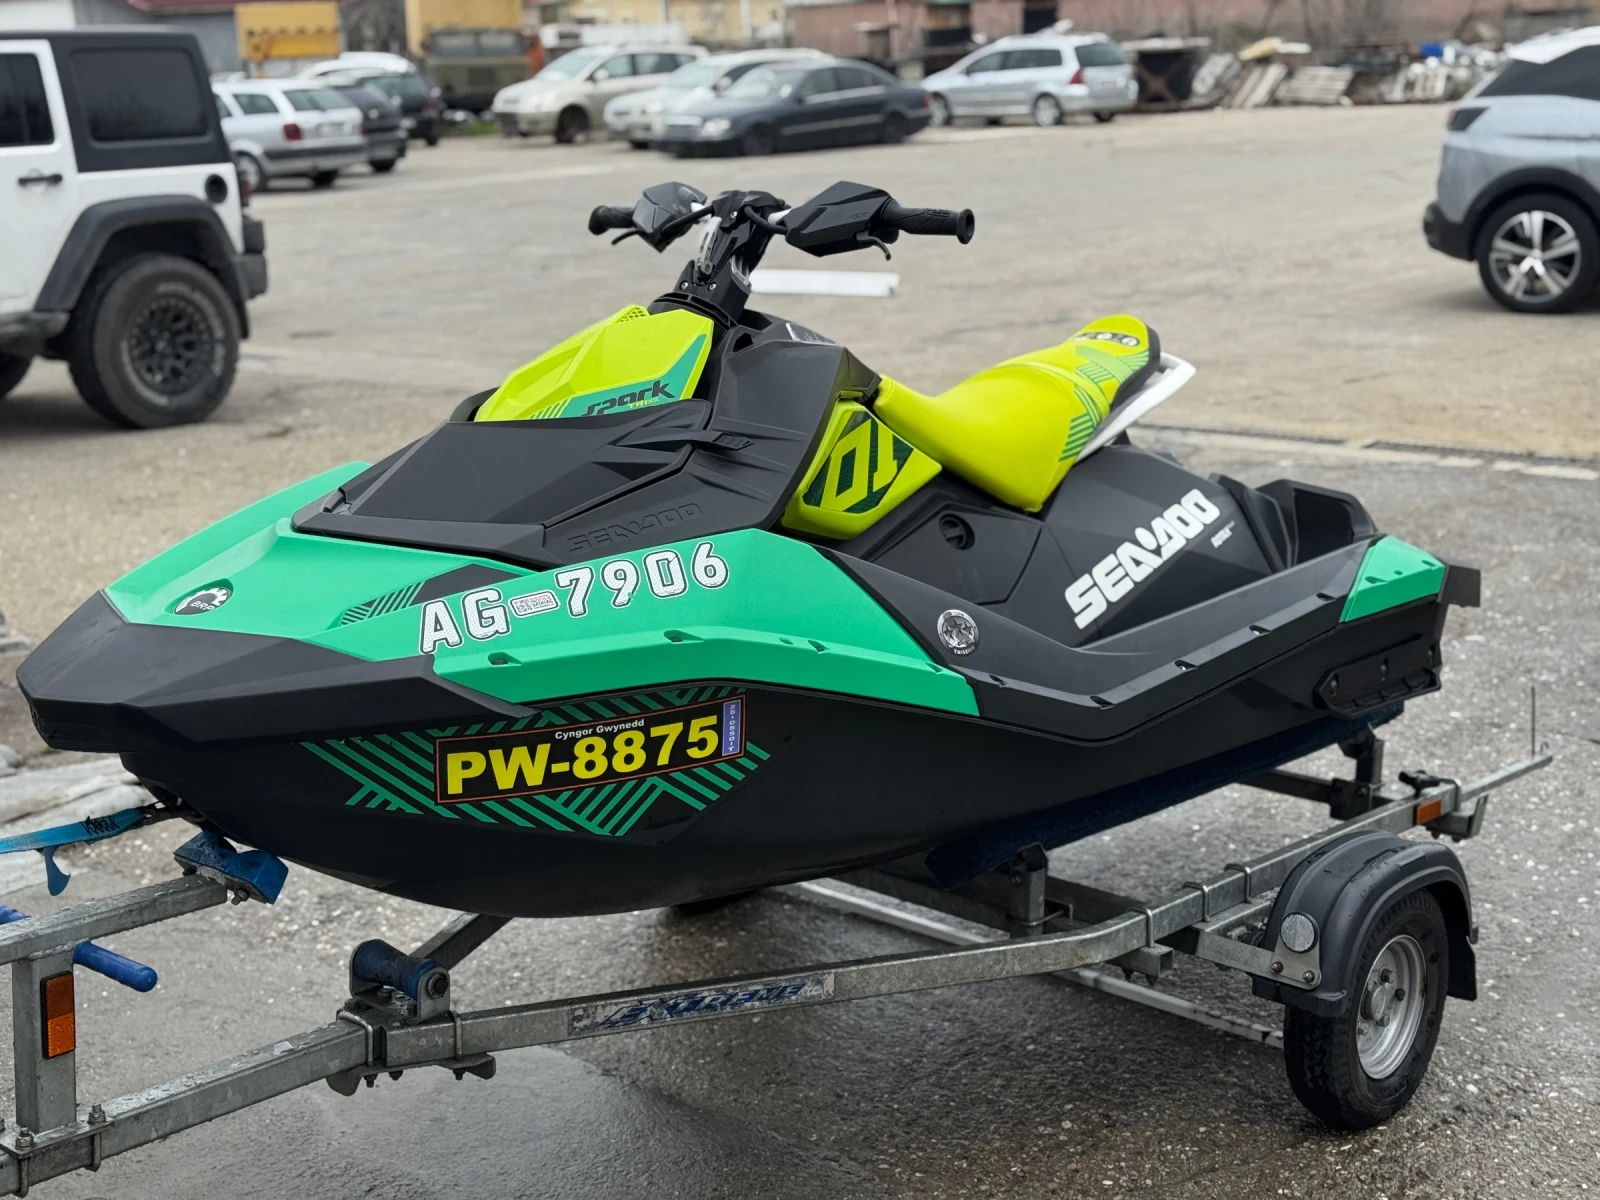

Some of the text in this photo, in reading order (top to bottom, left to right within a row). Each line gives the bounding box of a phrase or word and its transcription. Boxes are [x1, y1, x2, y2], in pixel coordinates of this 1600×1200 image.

[190, 601, 215, 611] BRP
[554, 718, 645, 741] Cyngor Gwynedd
[447, 714, 719, 795] PW-8875
